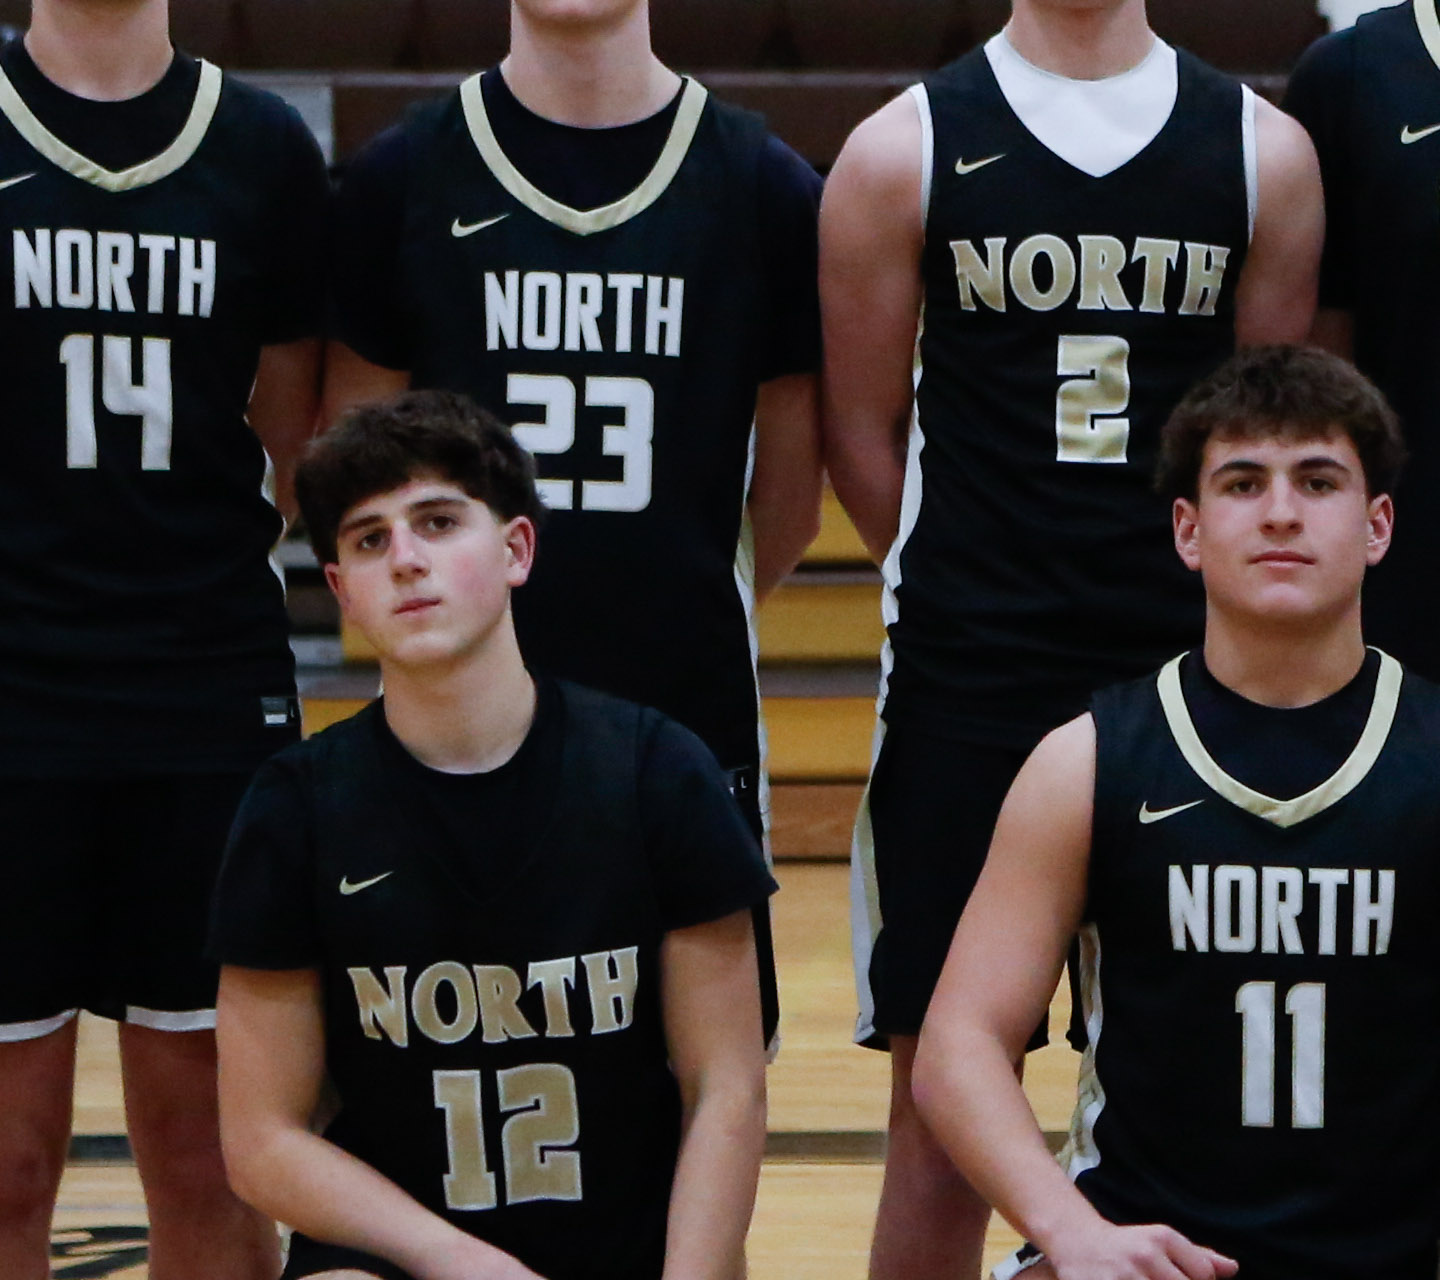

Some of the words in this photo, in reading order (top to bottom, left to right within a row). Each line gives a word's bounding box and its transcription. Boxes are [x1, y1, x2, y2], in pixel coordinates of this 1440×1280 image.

[13, 228, 216, 318] NORTH
[484, 270, 684, 357] NORTH
[949, 233, 1230, 316] NORTH
[59, 334, 173, 470] 14
[506, 373, 654, 512] 23
[1055, 335, 1130, 463] 2
[1168, 864, 1395, 956] NORTH
[347, 946, 638, 1048] NORTH
[1235, 981, 1326, 1128] 11
[432, 1063, 583, 1211] 12
